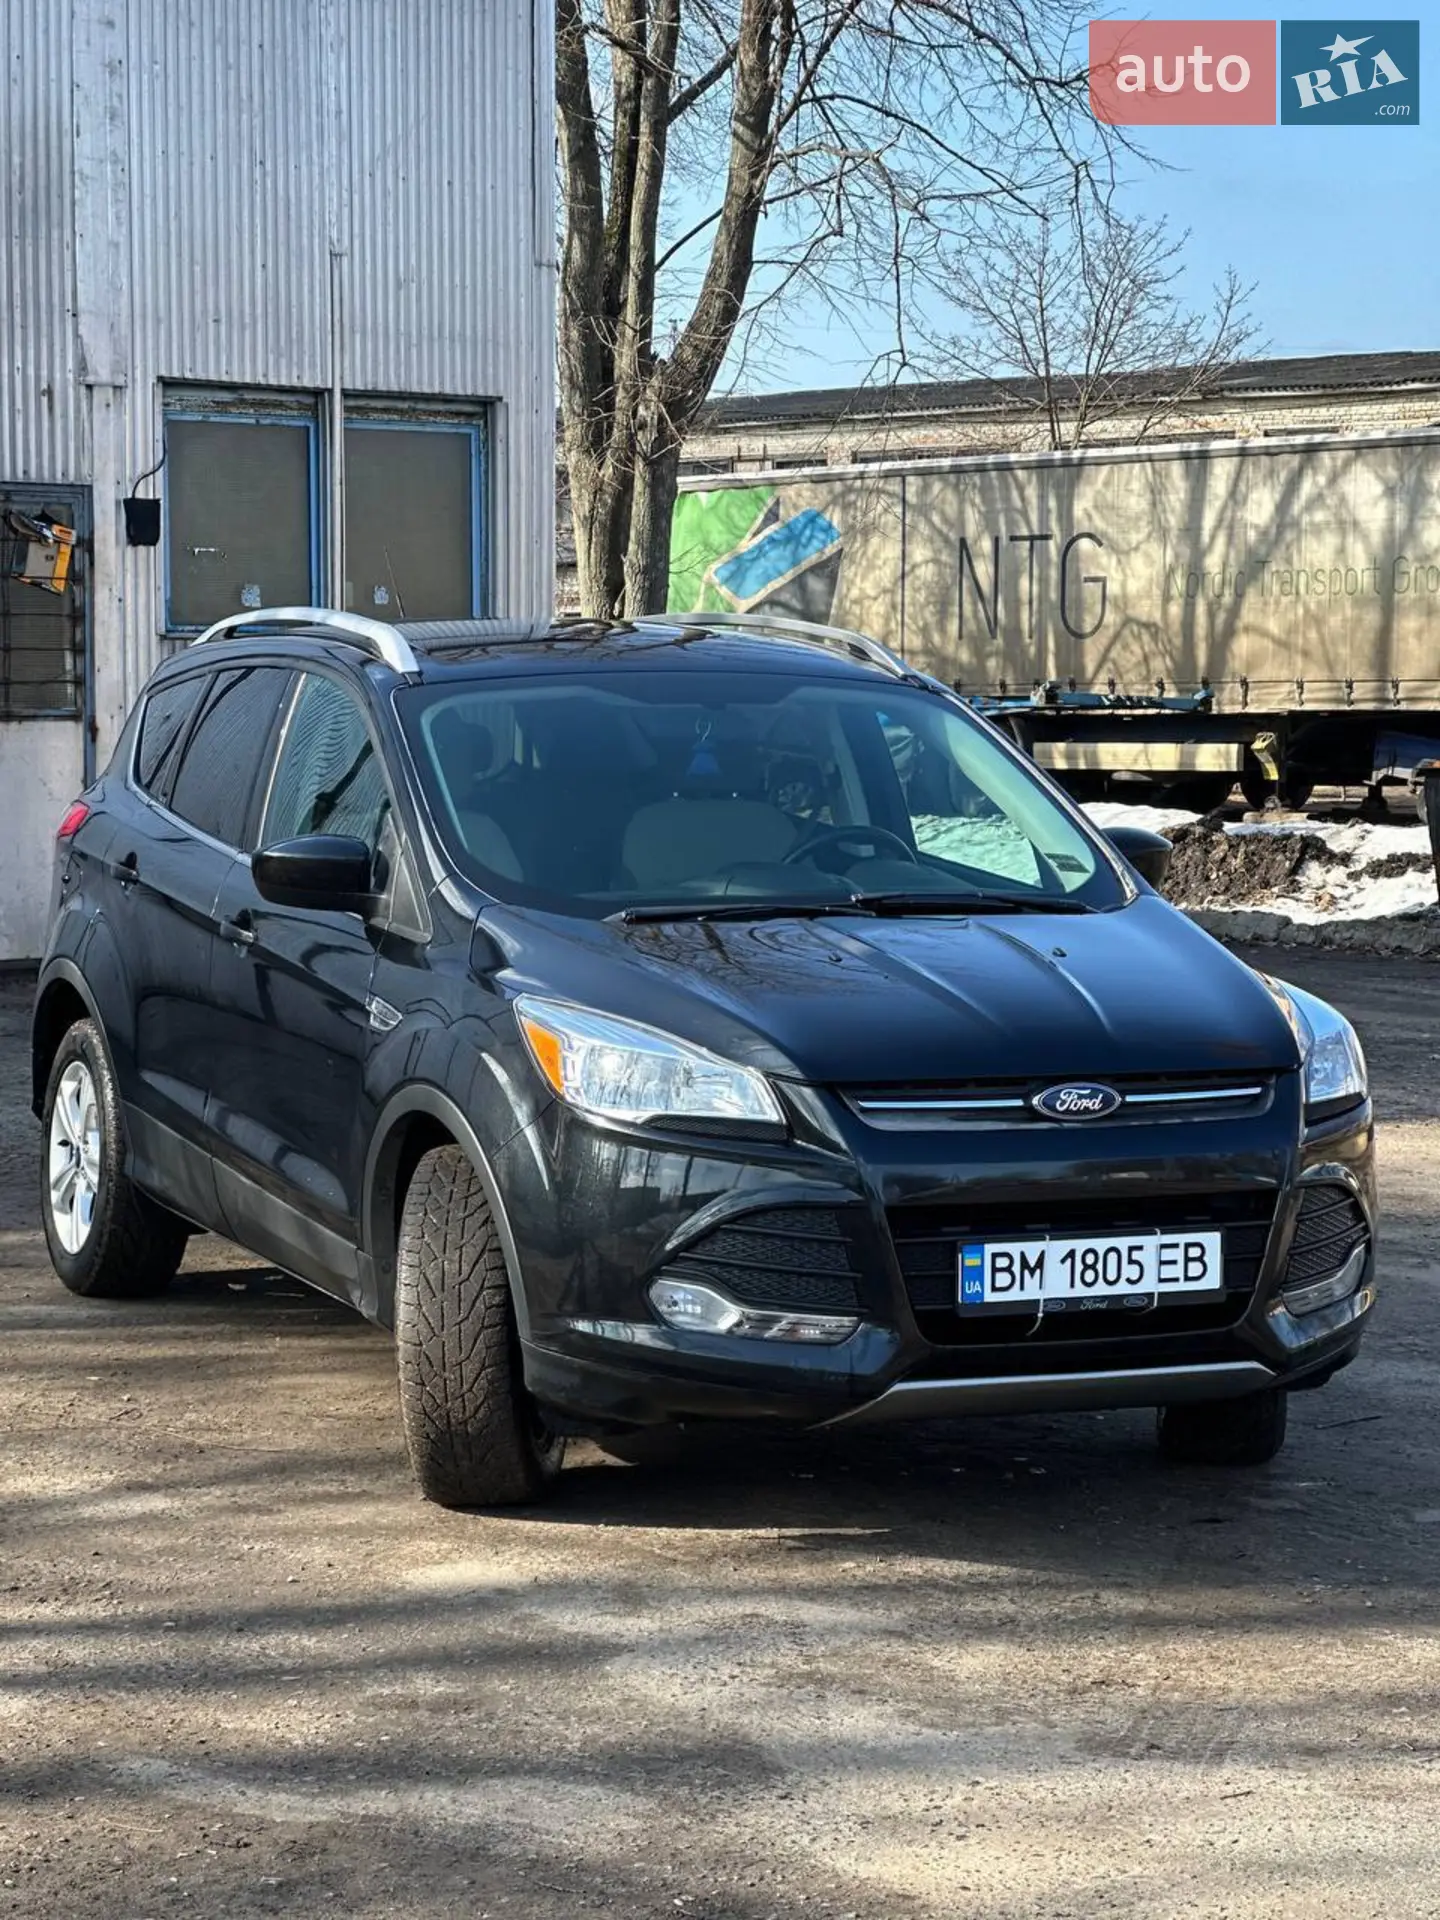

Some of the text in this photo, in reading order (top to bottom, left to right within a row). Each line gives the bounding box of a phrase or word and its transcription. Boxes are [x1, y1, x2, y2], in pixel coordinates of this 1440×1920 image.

[958, 532, 1107, 640] NTG
[1166, 555, 1440, 609] Nordic Transport Gro
[1056, 1088, 1103, 1111] Ford
[965, 1281, 982, 1294] UA
[991, 1242, 1208, 1293] BM 1805 EB
